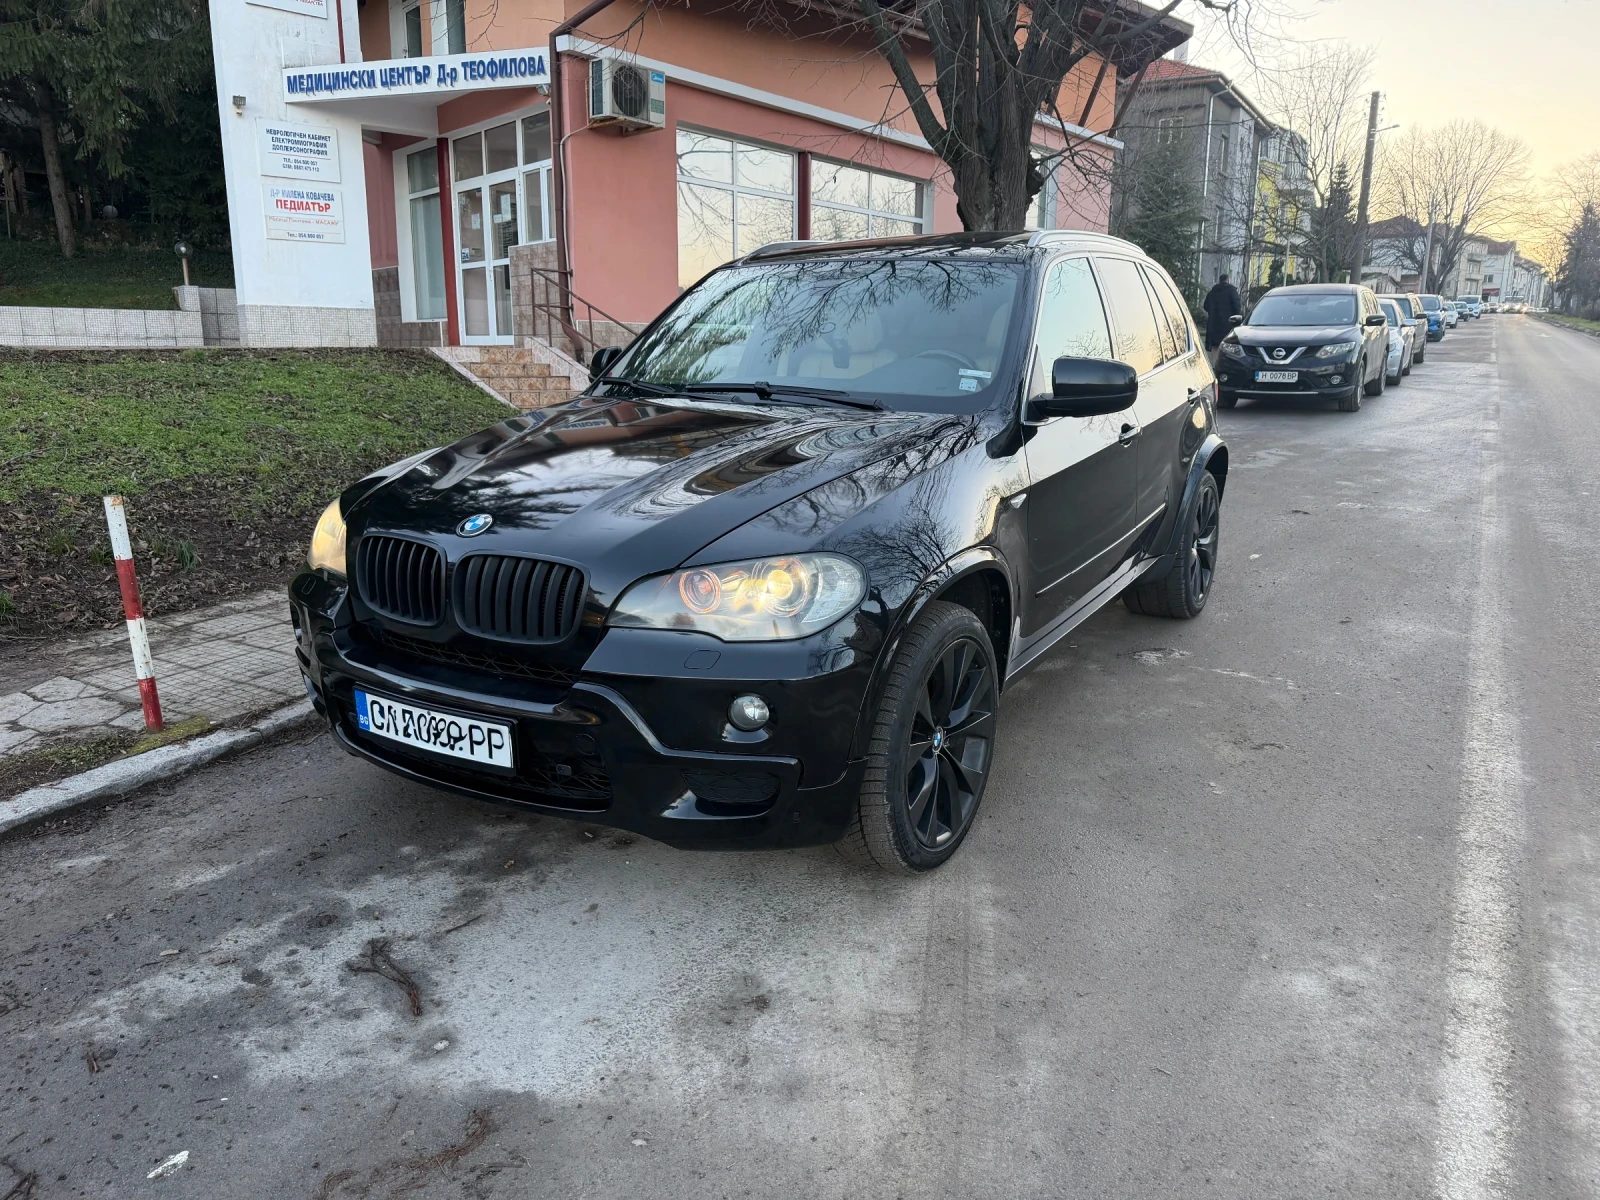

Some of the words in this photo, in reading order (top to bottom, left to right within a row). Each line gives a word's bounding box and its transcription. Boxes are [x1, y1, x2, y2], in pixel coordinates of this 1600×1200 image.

[287, 69, 376, 96] МЕДИЦИНСКИ
[380, 65, 431, 90] ЦЕНТЪР
[461, 55, 546, 81] ТЕОФИЛОВА
[271, 137, 327, 149] ЕЛЕКТРОМИОГРАФИЯ
[308, 133, 331, 142] КАБИНЕТ
[272, 144, 328, 156] ДОПЛЕРСОНОГРАФИЯ
[306, 191, 335, 202] КОВАЧЕВА
[275, 199, 331, 213] ПЕДИАТЪР
[359, 714, 369, 726] BG
